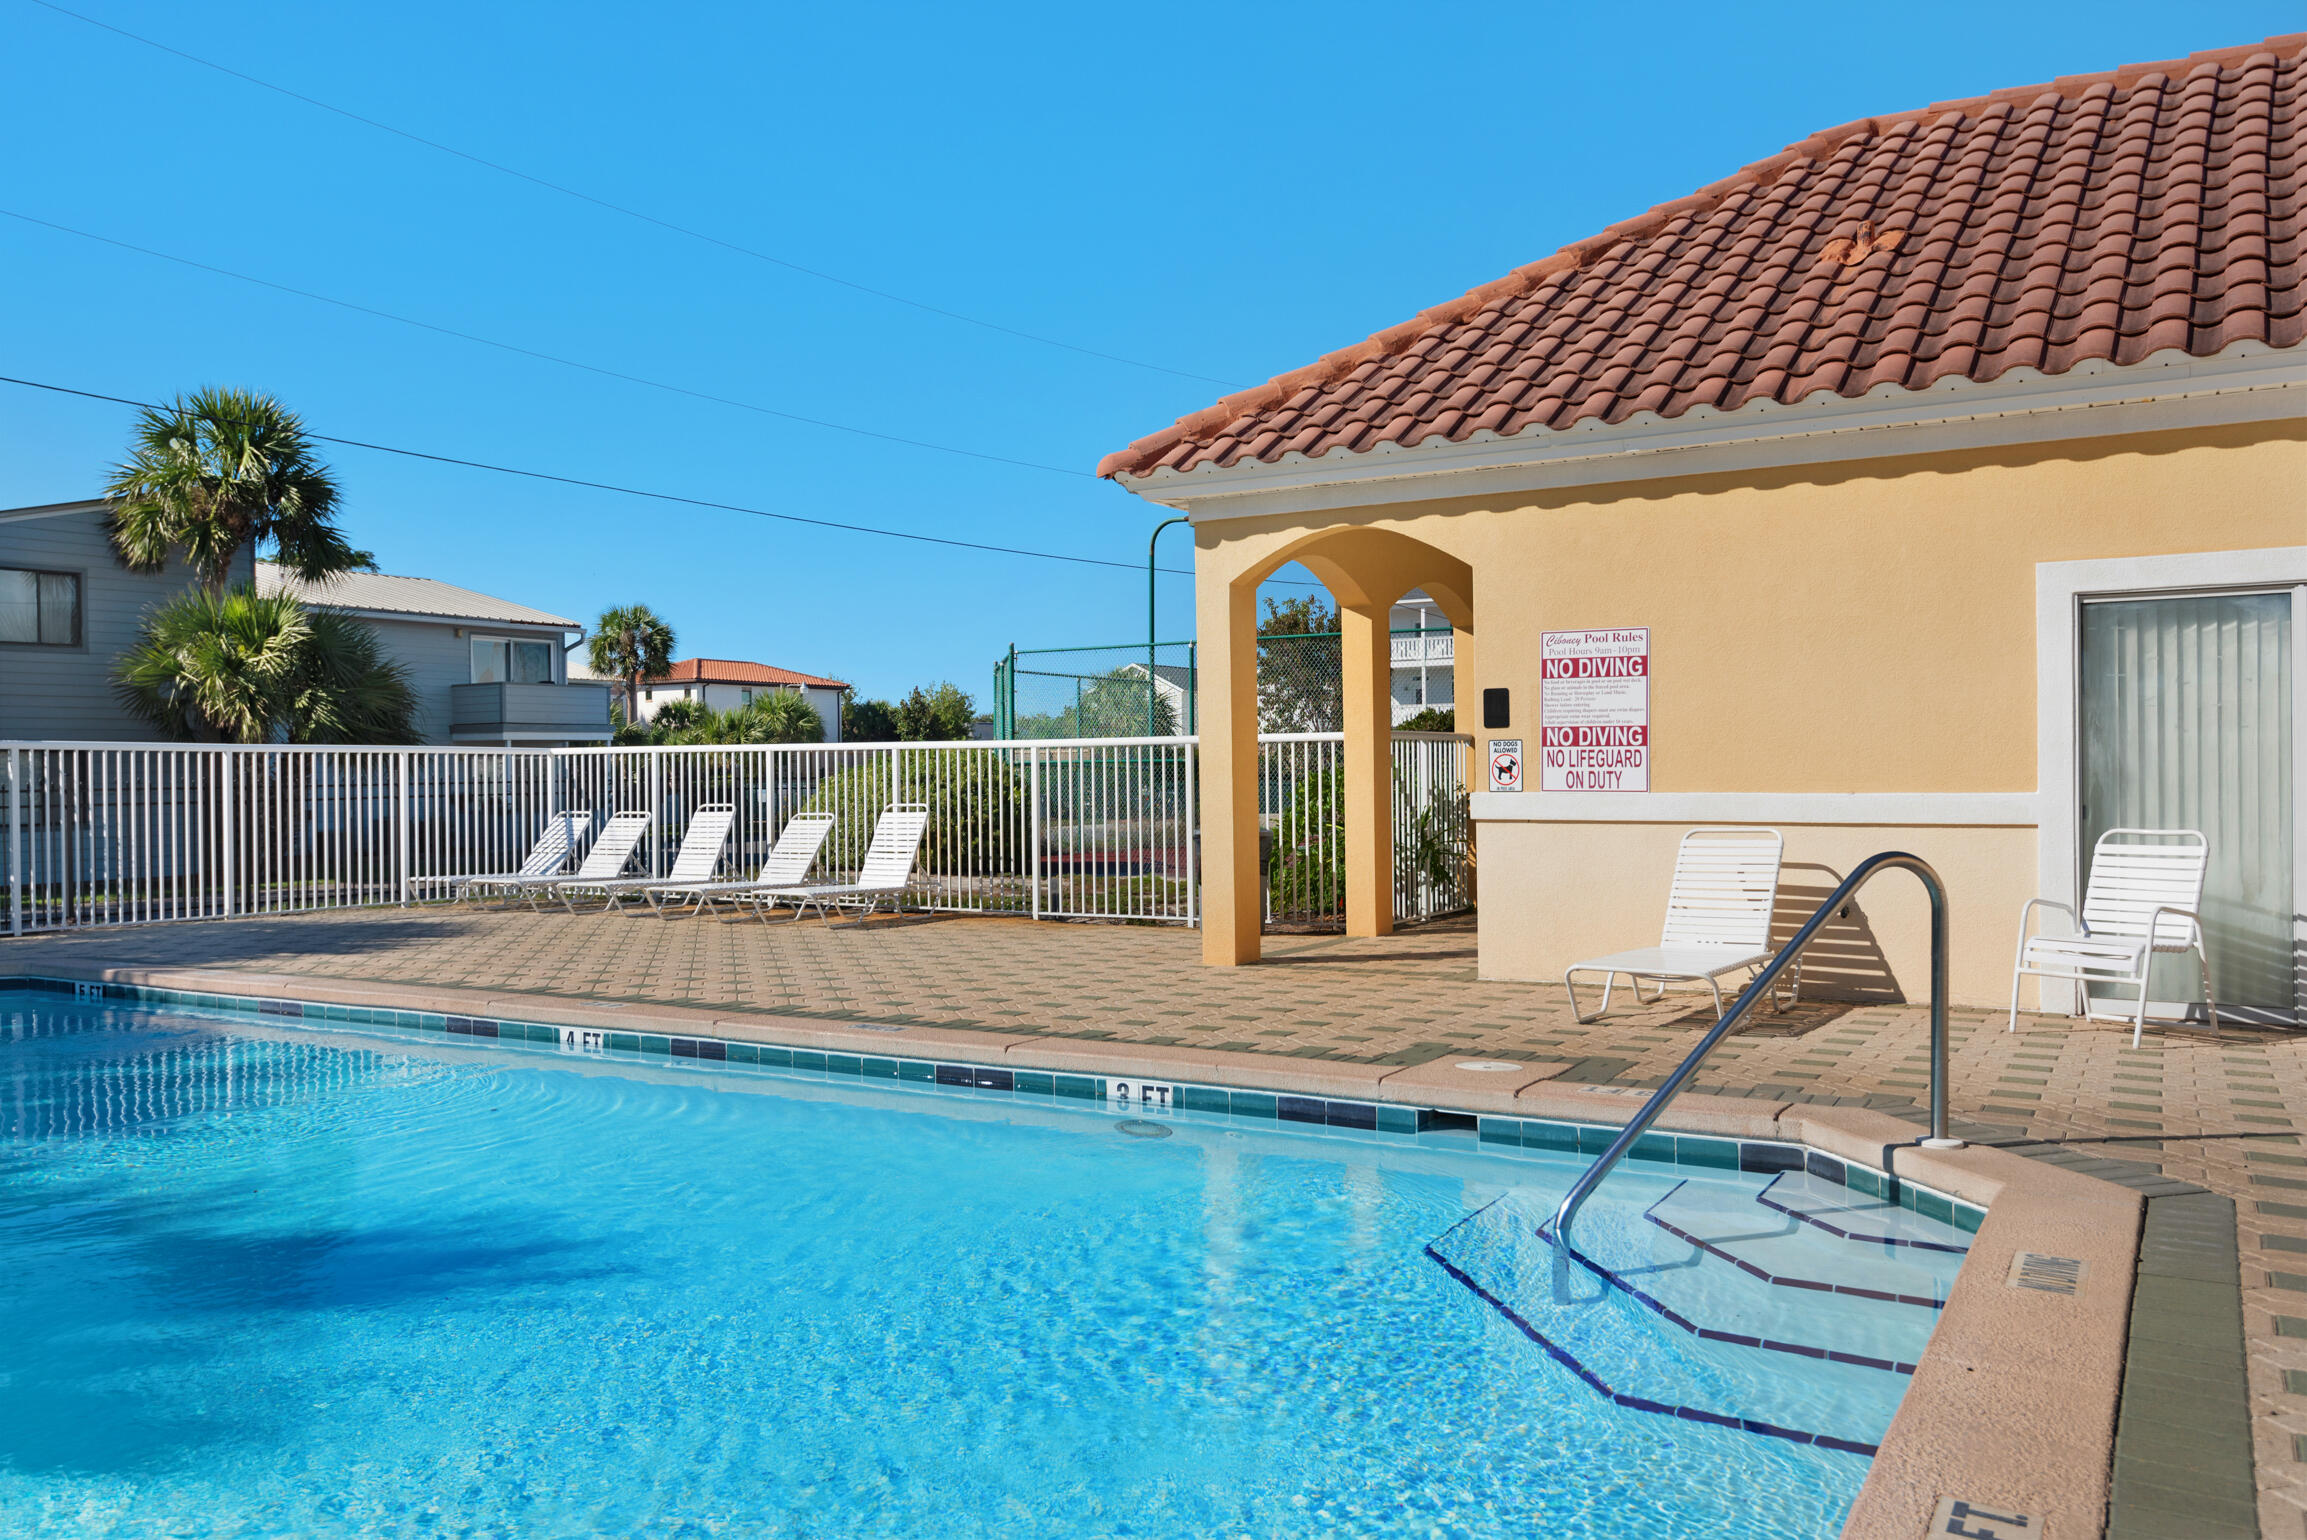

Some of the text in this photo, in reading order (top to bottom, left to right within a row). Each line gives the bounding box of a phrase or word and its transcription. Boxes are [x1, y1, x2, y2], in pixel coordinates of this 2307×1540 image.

[1585, 633, 1608, 644] Pool
[1612, 632, 1643, 643] Rules
[1548, 648, 1566, 656] Pool
[1569, 647, 1592, 656] Hours
[1546, 656, 1643, 678] NO DIVING
[1546, 726, 1643, 746] NO DIVING
[1547, 749, 1643, 768] NO LIFEGUARD
[1566, 770, 1622, 789] ON DUTY
[90, 985, 101, 997] FT
[566, 1031, 600, 1045] 4 FT
[1117, 1083, 1169, 1104] 3 FT
